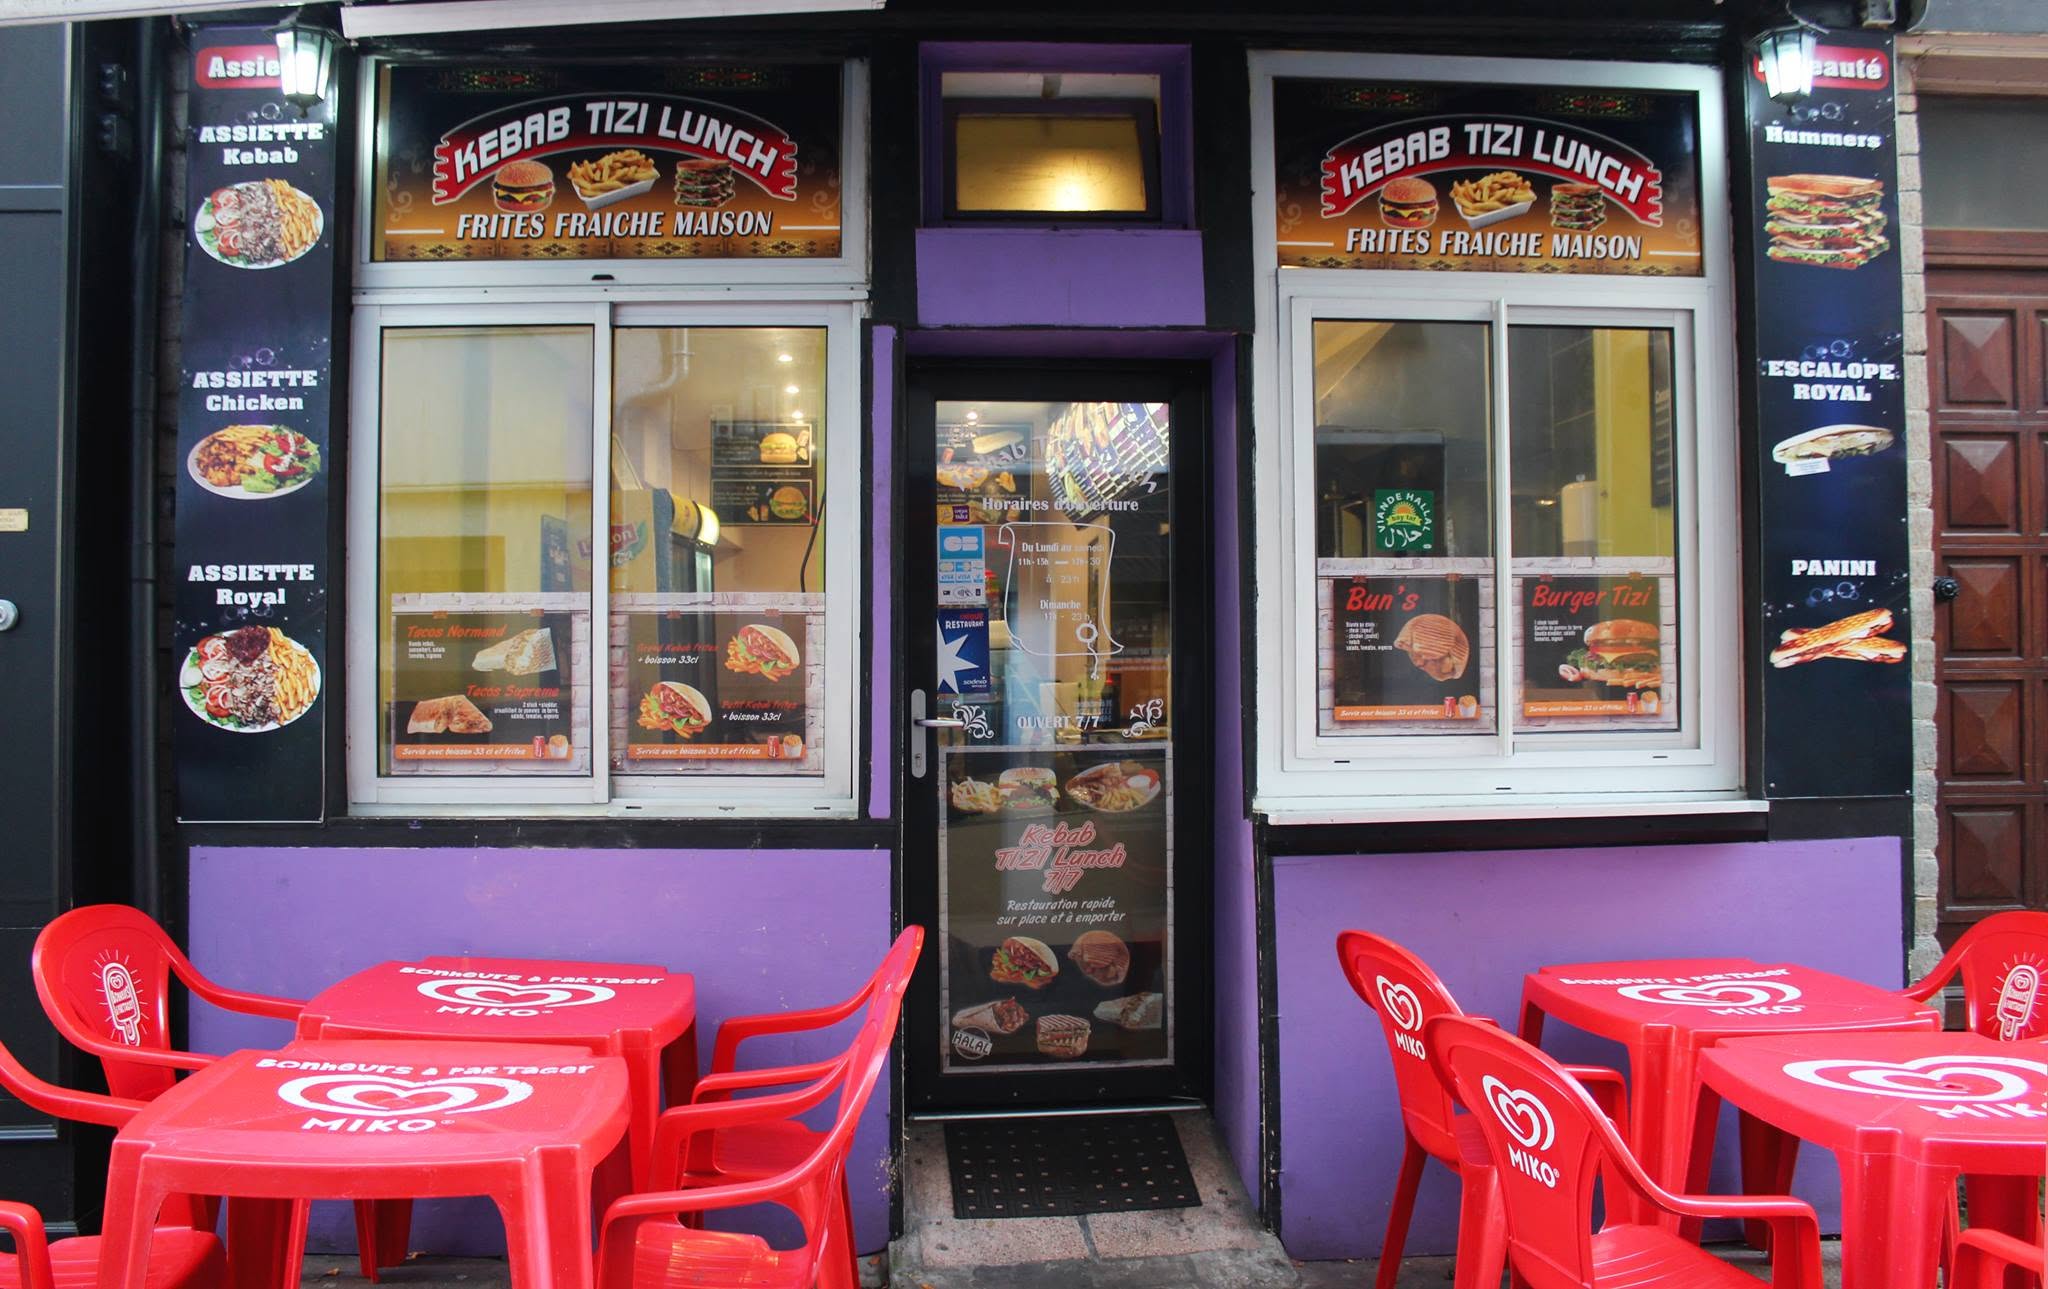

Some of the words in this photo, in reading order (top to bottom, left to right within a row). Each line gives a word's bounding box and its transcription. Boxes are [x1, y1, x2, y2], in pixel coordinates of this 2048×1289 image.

[199, 123, 324, 143] ASSIETTE
[1765, 126, 1882, 149] Hummers
[455, 107, 571, 183] KEBAB
[585, 102, 650, 135] TIZI
[658, 105, 779, 178] LUNCH
[223, 147, 299, 165] Kebab
[1340, 127, 1451, 198] KEBAB
[1464, 123, 1524, 157] TIZI
[1533, 130, 1645, 203] LUNCH
[456, 213, 546, 239] FRITES
[553, 212, 664, 238] FRAICHE
[672, 210, 773, 236] MAISON
[1346, 228, 1431, 254] FRITES
[1440, 230, 1543, 258] FRAICHE
[1551, 233, 1642, 260] MAISON
[192, 370, 318, 388] ASSIETTE
[1767, 360, 1896, 380] ESCALOPE
[1793, 384, 1872, 401] ROYAL
[205, 394, 304, 412] Chicken
[982, 497, 1049, 511] Horaires
[1377, 493, 1402, 533] VIANDE
[1406, 493, 1432, 532] HALLAL
[1022, 543, 1034, 552] Du
[1036, 543, 1059, 552] Lundi
[188, 564, 315, 582] ASSIETTE
[1792, 560, 1876, 576] PANINI
[216, 588, 286, 608] Royal
[1345, 585, 1420, 612] Bun's
[1532, 585, 1607, 613] Burger
[1612, 585, 1653, 607] Tizi
[407, 625, 445, 639] Tacos
[448, 623, 508, 639] Normand
[945, 621, 985, 630] RESTAURANT
[645, 655, 677, 664] boisson
[678, 656, 699, 664] 33cl
[466, 684, 501, 697] Tacos
[729, 711, 760, 720] boisson
[761, 712, 782, 720] 33cl
[1017, 716, 1070, 729] OUVERT
[1076, 715, 1101, 729] 7/7
[637, 747, 660, 756] Servis
[1020, 821, 1096, 846] Kebab
[1051, 843, 1126, 869] Lunch
[1042, 869, 1084, 894] 7/7
[1007, 898, 1079, 911] Restauration
[1081, 897, 1115, 912] rapide
[996, 916, 1016, 925] sur
[1018, 913, 1048, 927] place
[1051, 912, 1065, 923] et
[1066, 912, 1074, 923] à
[1075, 910, 1126, 924] emporter
[436, 1005, 540, 1017] MIKO
[1708, 1003, 1797, 1017] MIKO
[953, 1031, 992, 1056] HALAL
[1394, 1030, 1426, 1061] MIKO
[1917, 1103, 2048, 1119] MIK
[300, 1116, 437, 1134] MIKO
[1507, 1143, 1557, 1188] MIKO
